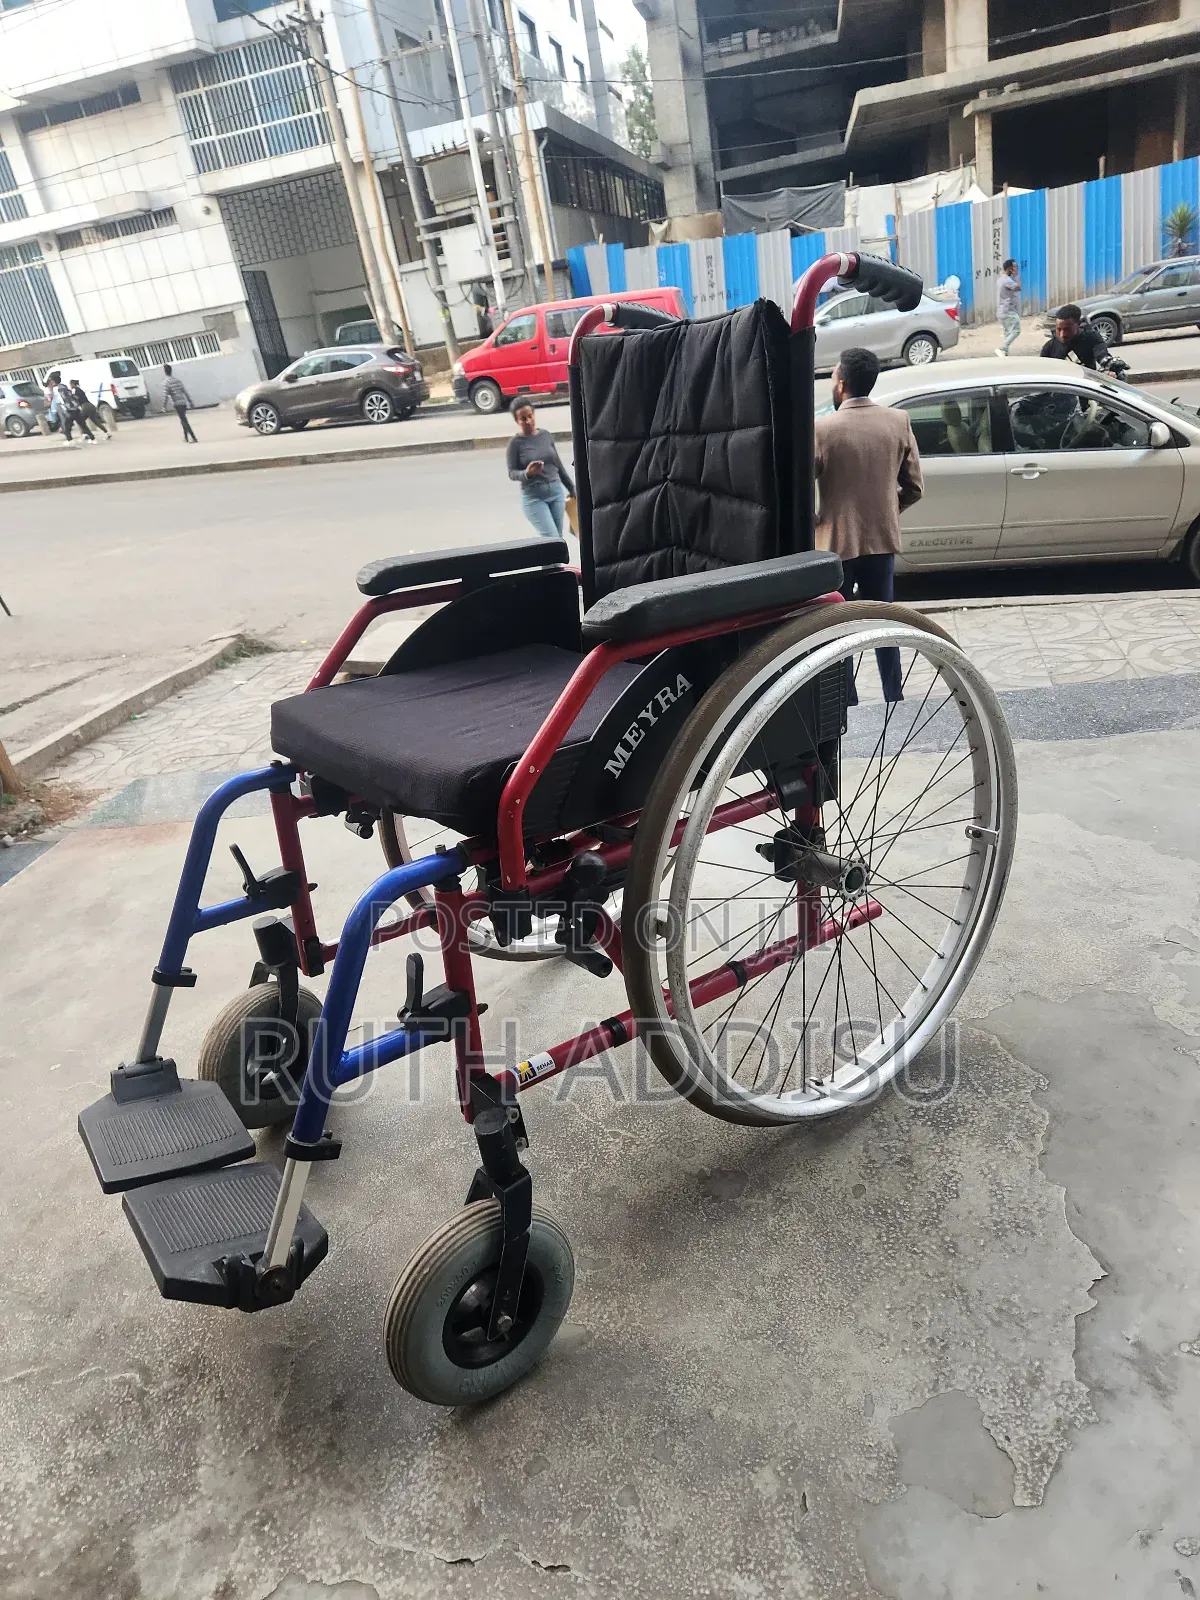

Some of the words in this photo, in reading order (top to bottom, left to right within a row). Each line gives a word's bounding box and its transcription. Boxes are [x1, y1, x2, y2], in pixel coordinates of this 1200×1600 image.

[910, 536, 973, 547] EXECUTIVE
[604, 673, 694, 779] MEYRA
[536, 1060, 554, 1071] REHAB
